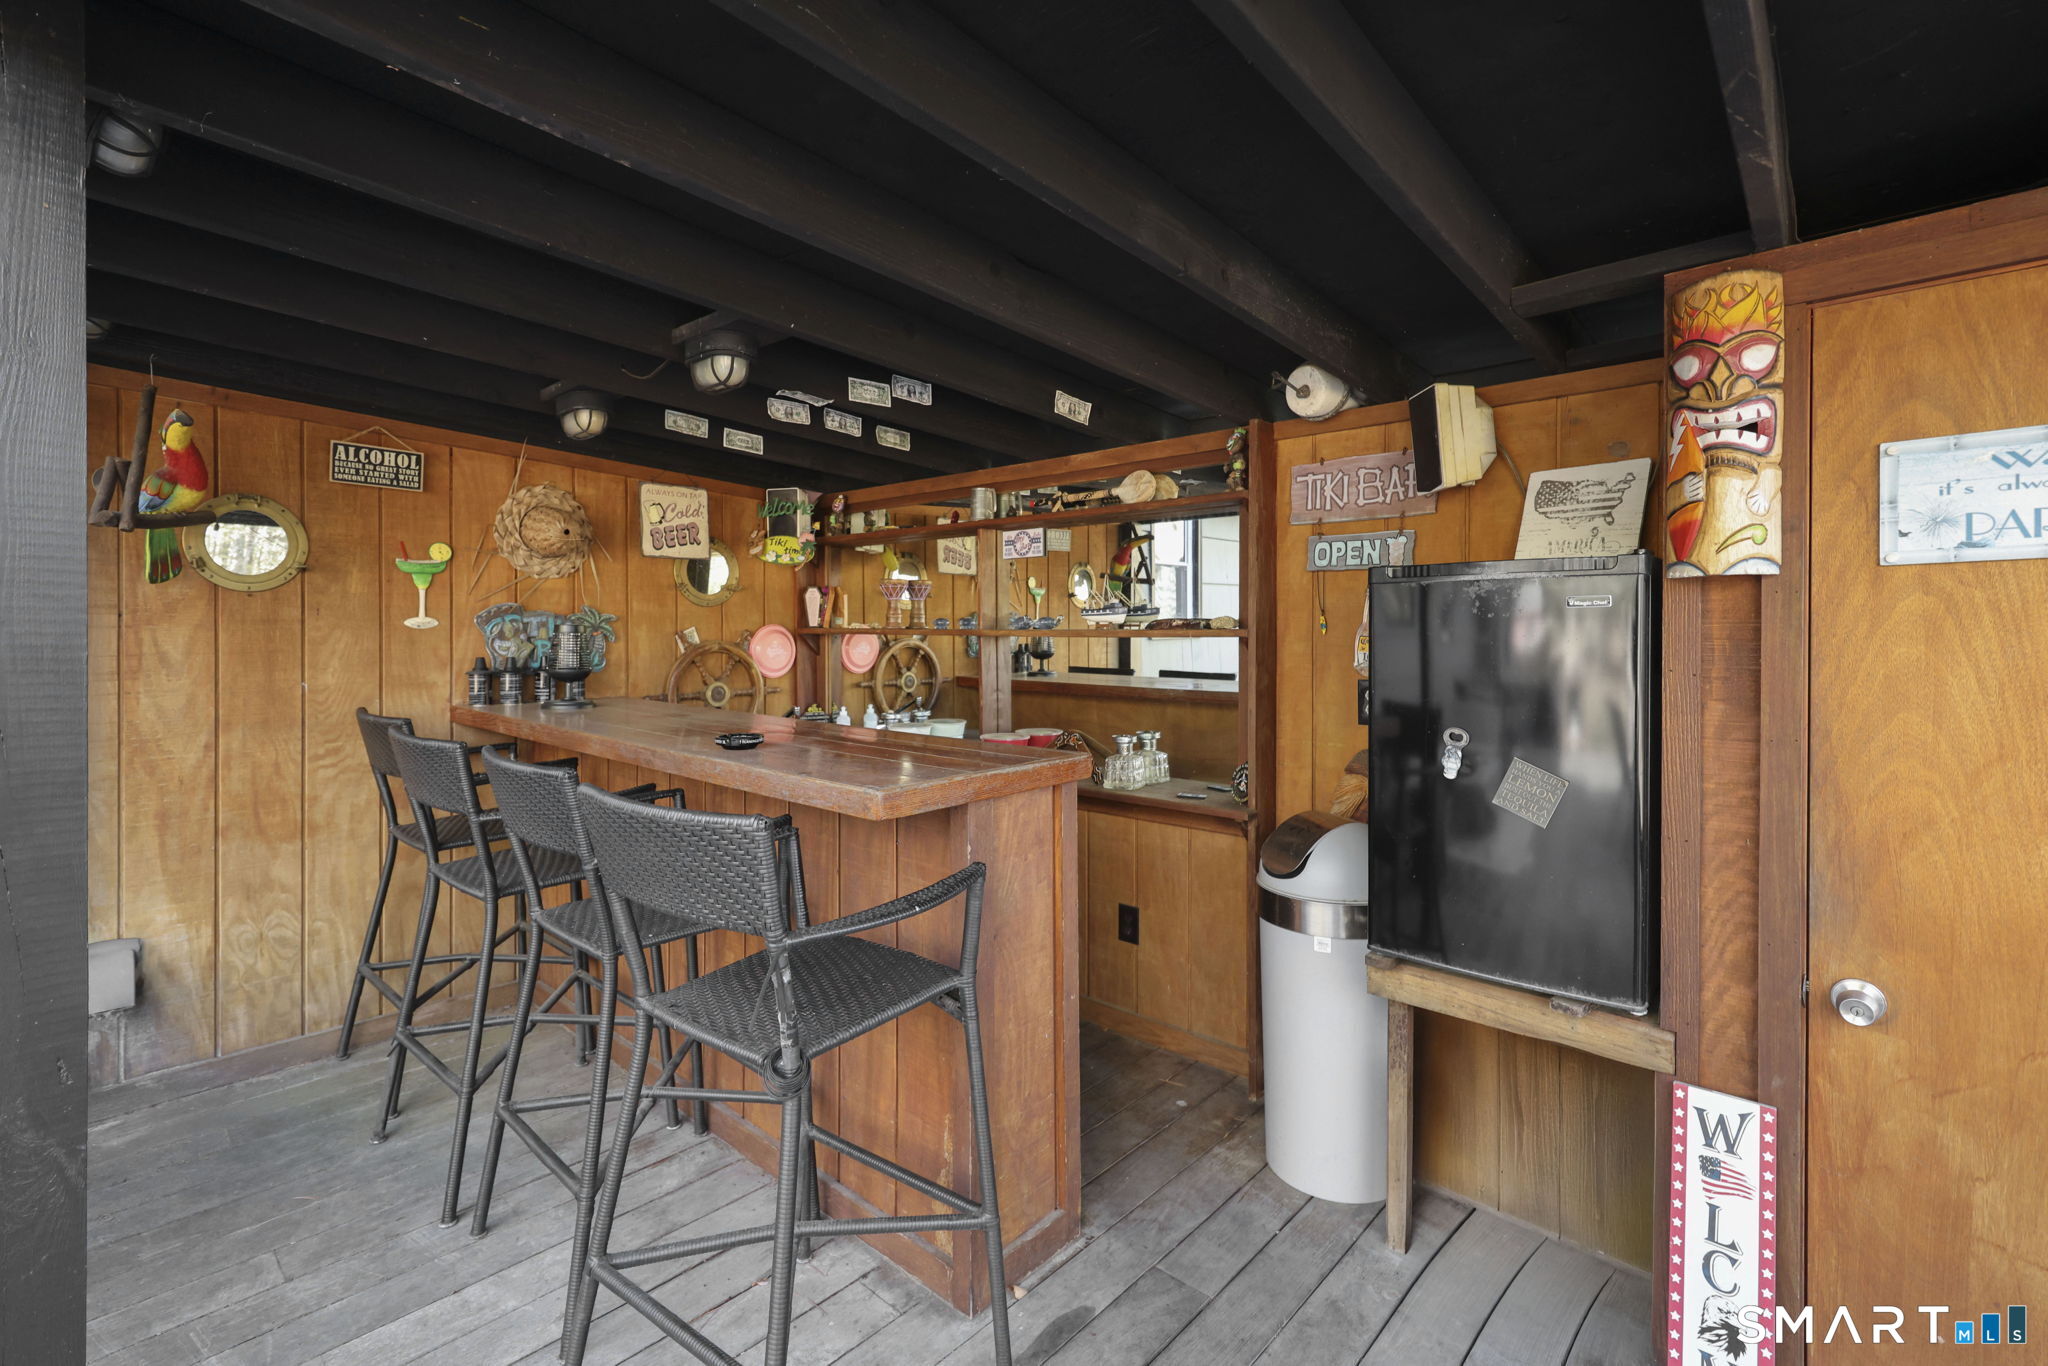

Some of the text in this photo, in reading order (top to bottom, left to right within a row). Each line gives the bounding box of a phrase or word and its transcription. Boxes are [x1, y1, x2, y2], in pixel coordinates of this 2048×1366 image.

[334, 460, 362, 470] BECAUSE
[376, 465, 396, 473] GREAT
[398, 468, 419, 476] STORY
[335, 445, 419, 470] ALCOHOL
[334, 466, 419, 482] EVER STARTED WITH
[334, 472, 365, 482] SOMEONE
[367, 477, 391, 485] EATING
[399, 480, 419, 488] SALAD
[645, 488, 675, 497] ALWAYS
[1296, 470, 1350, 512] TIKI
[1938, 478, 1975, 497] it's
[663, 501, 702, 522] Cold
[650, 522, 701, 550] BEER
[769, 538, 788, 547] Tiki
[1314, 539, 1381, 567] OPEN
[1511, 768, 1537, 784] HANDS
[1516, 761, 1565, 788] WHEN LIFE
[1508, 774, 1557, 803] LEMON
[1496, 797, 1545, 824] AND SALT
[1502, 789, 1548, 818] TEQUILA
